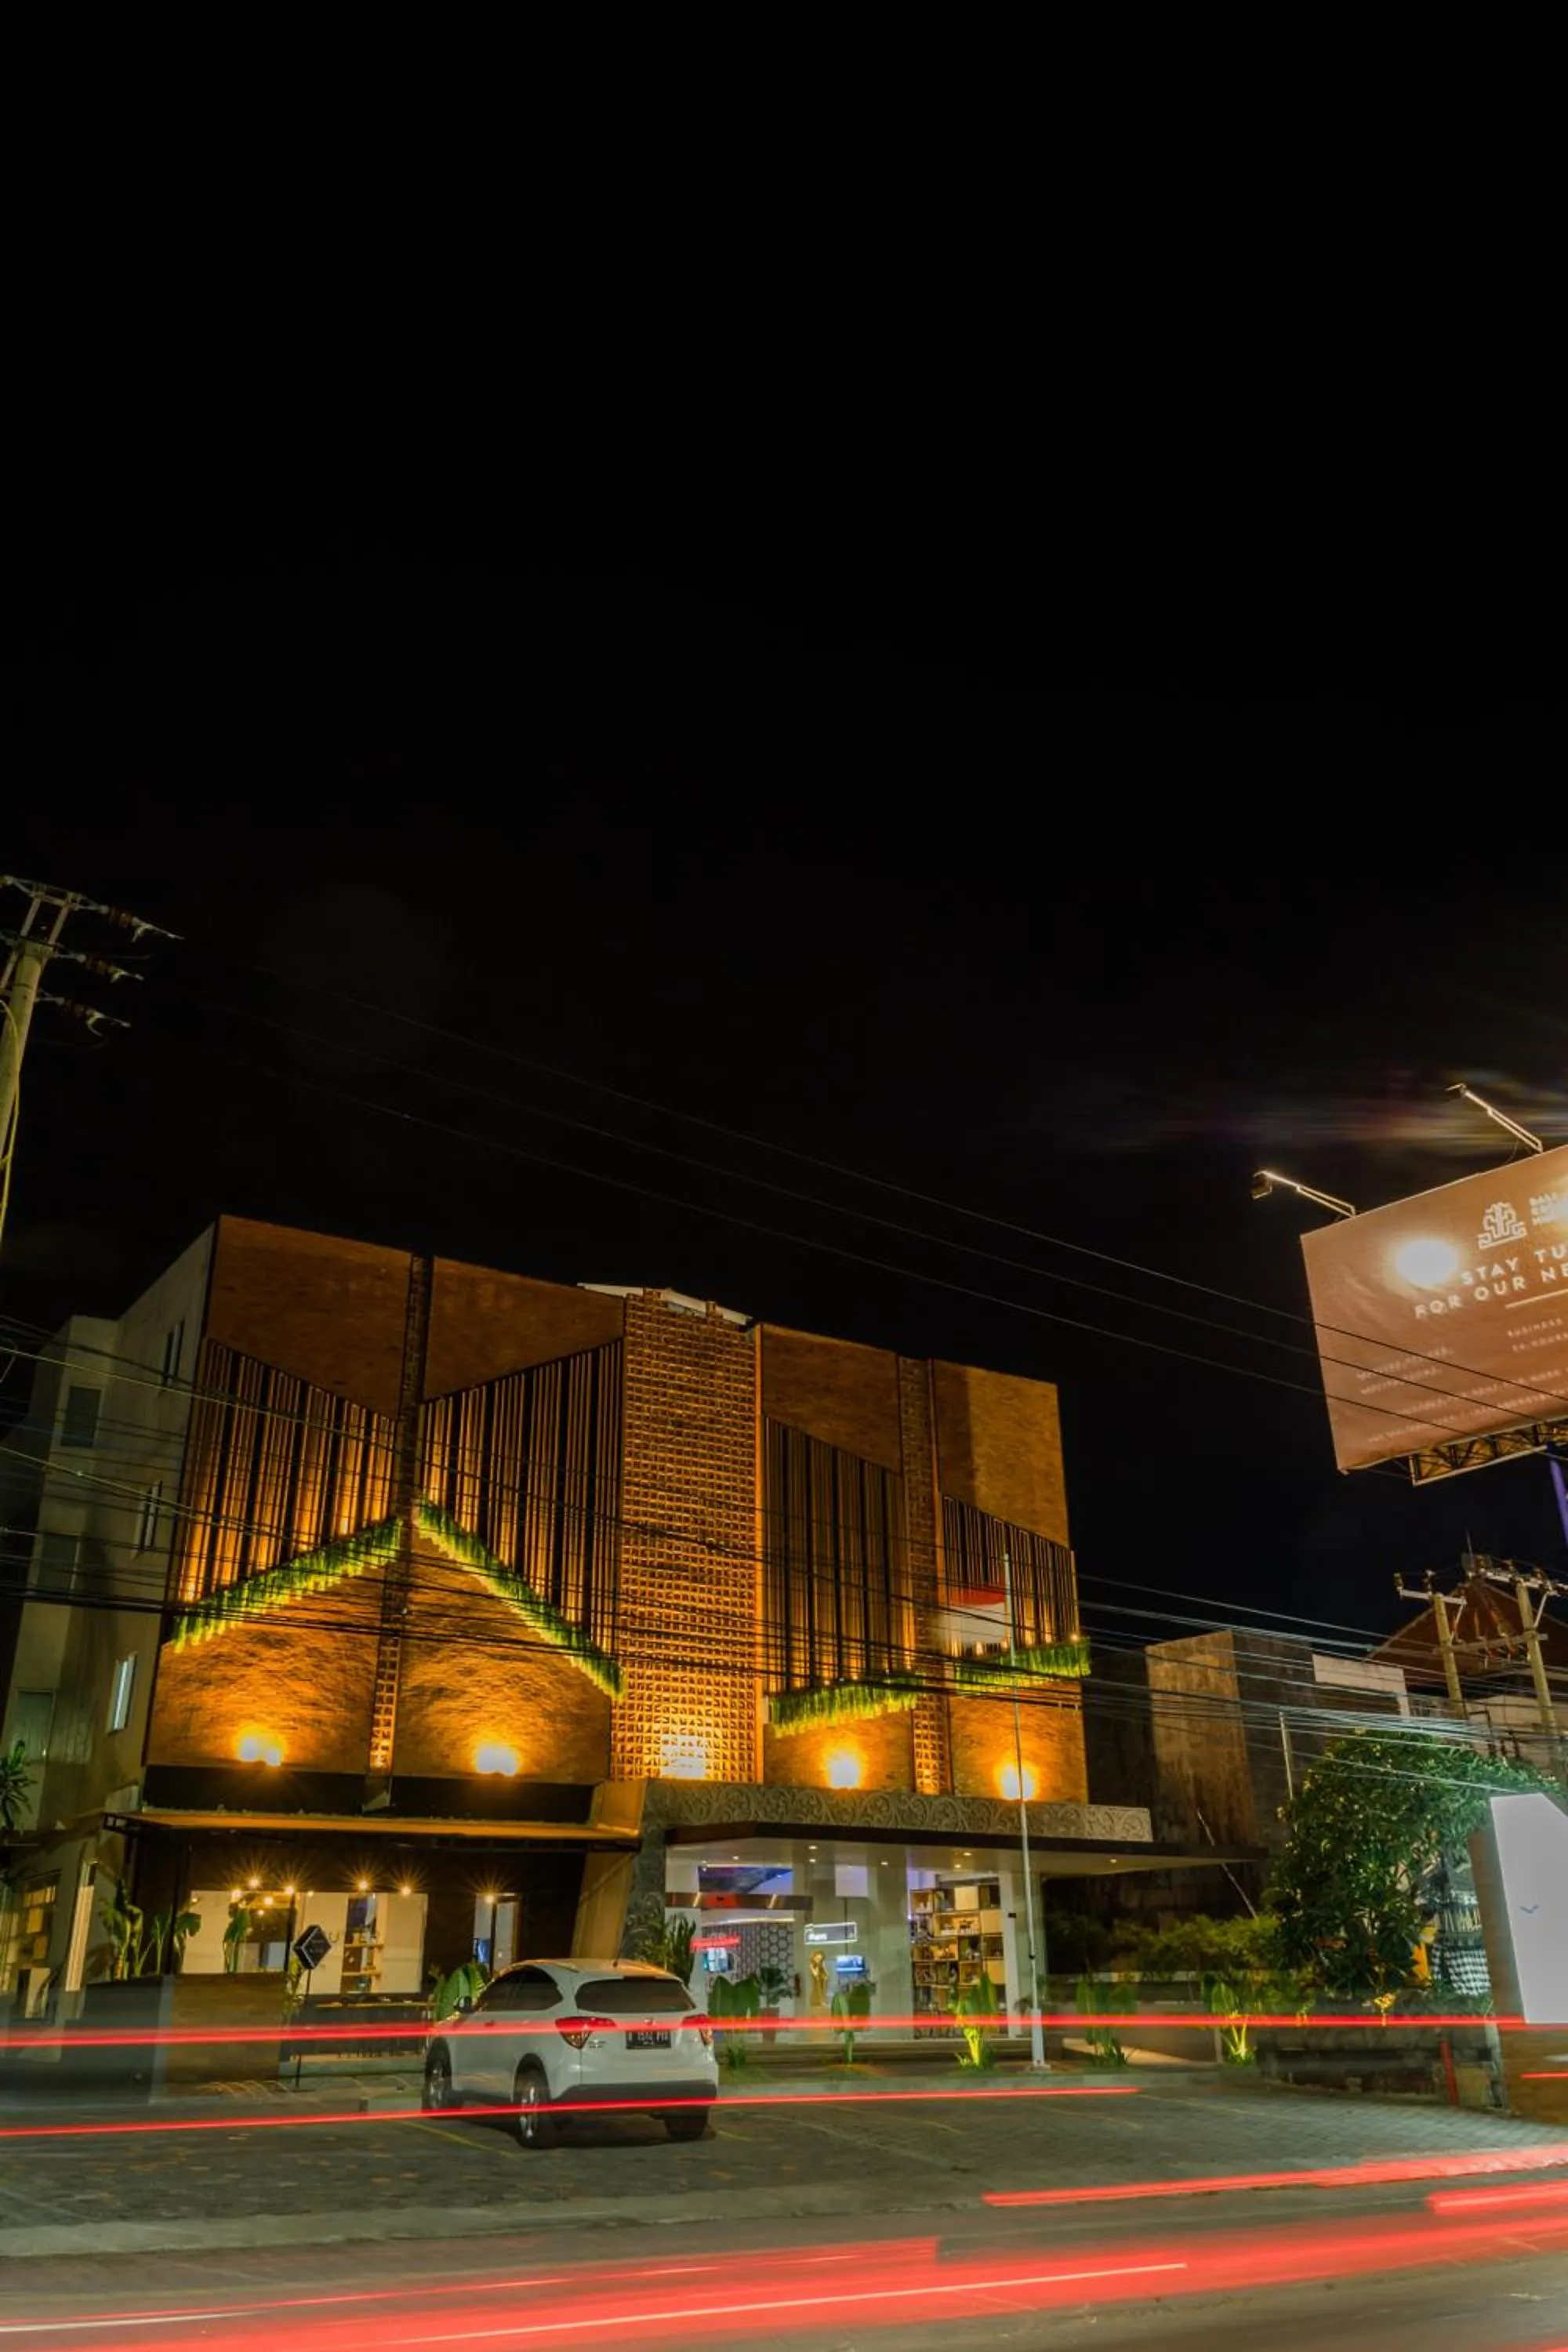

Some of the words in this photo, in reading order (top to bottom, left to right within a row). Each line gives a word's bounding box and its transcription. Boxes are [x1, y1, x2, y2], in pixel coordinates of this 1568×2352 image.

[1461, 1257, 1519, 1285] STAY
[1534, 1243, 1567, 1263] TU
[1414, 1294, 1462, 1319] FOR
[1474, 1276, 1526, 1301] OUR
